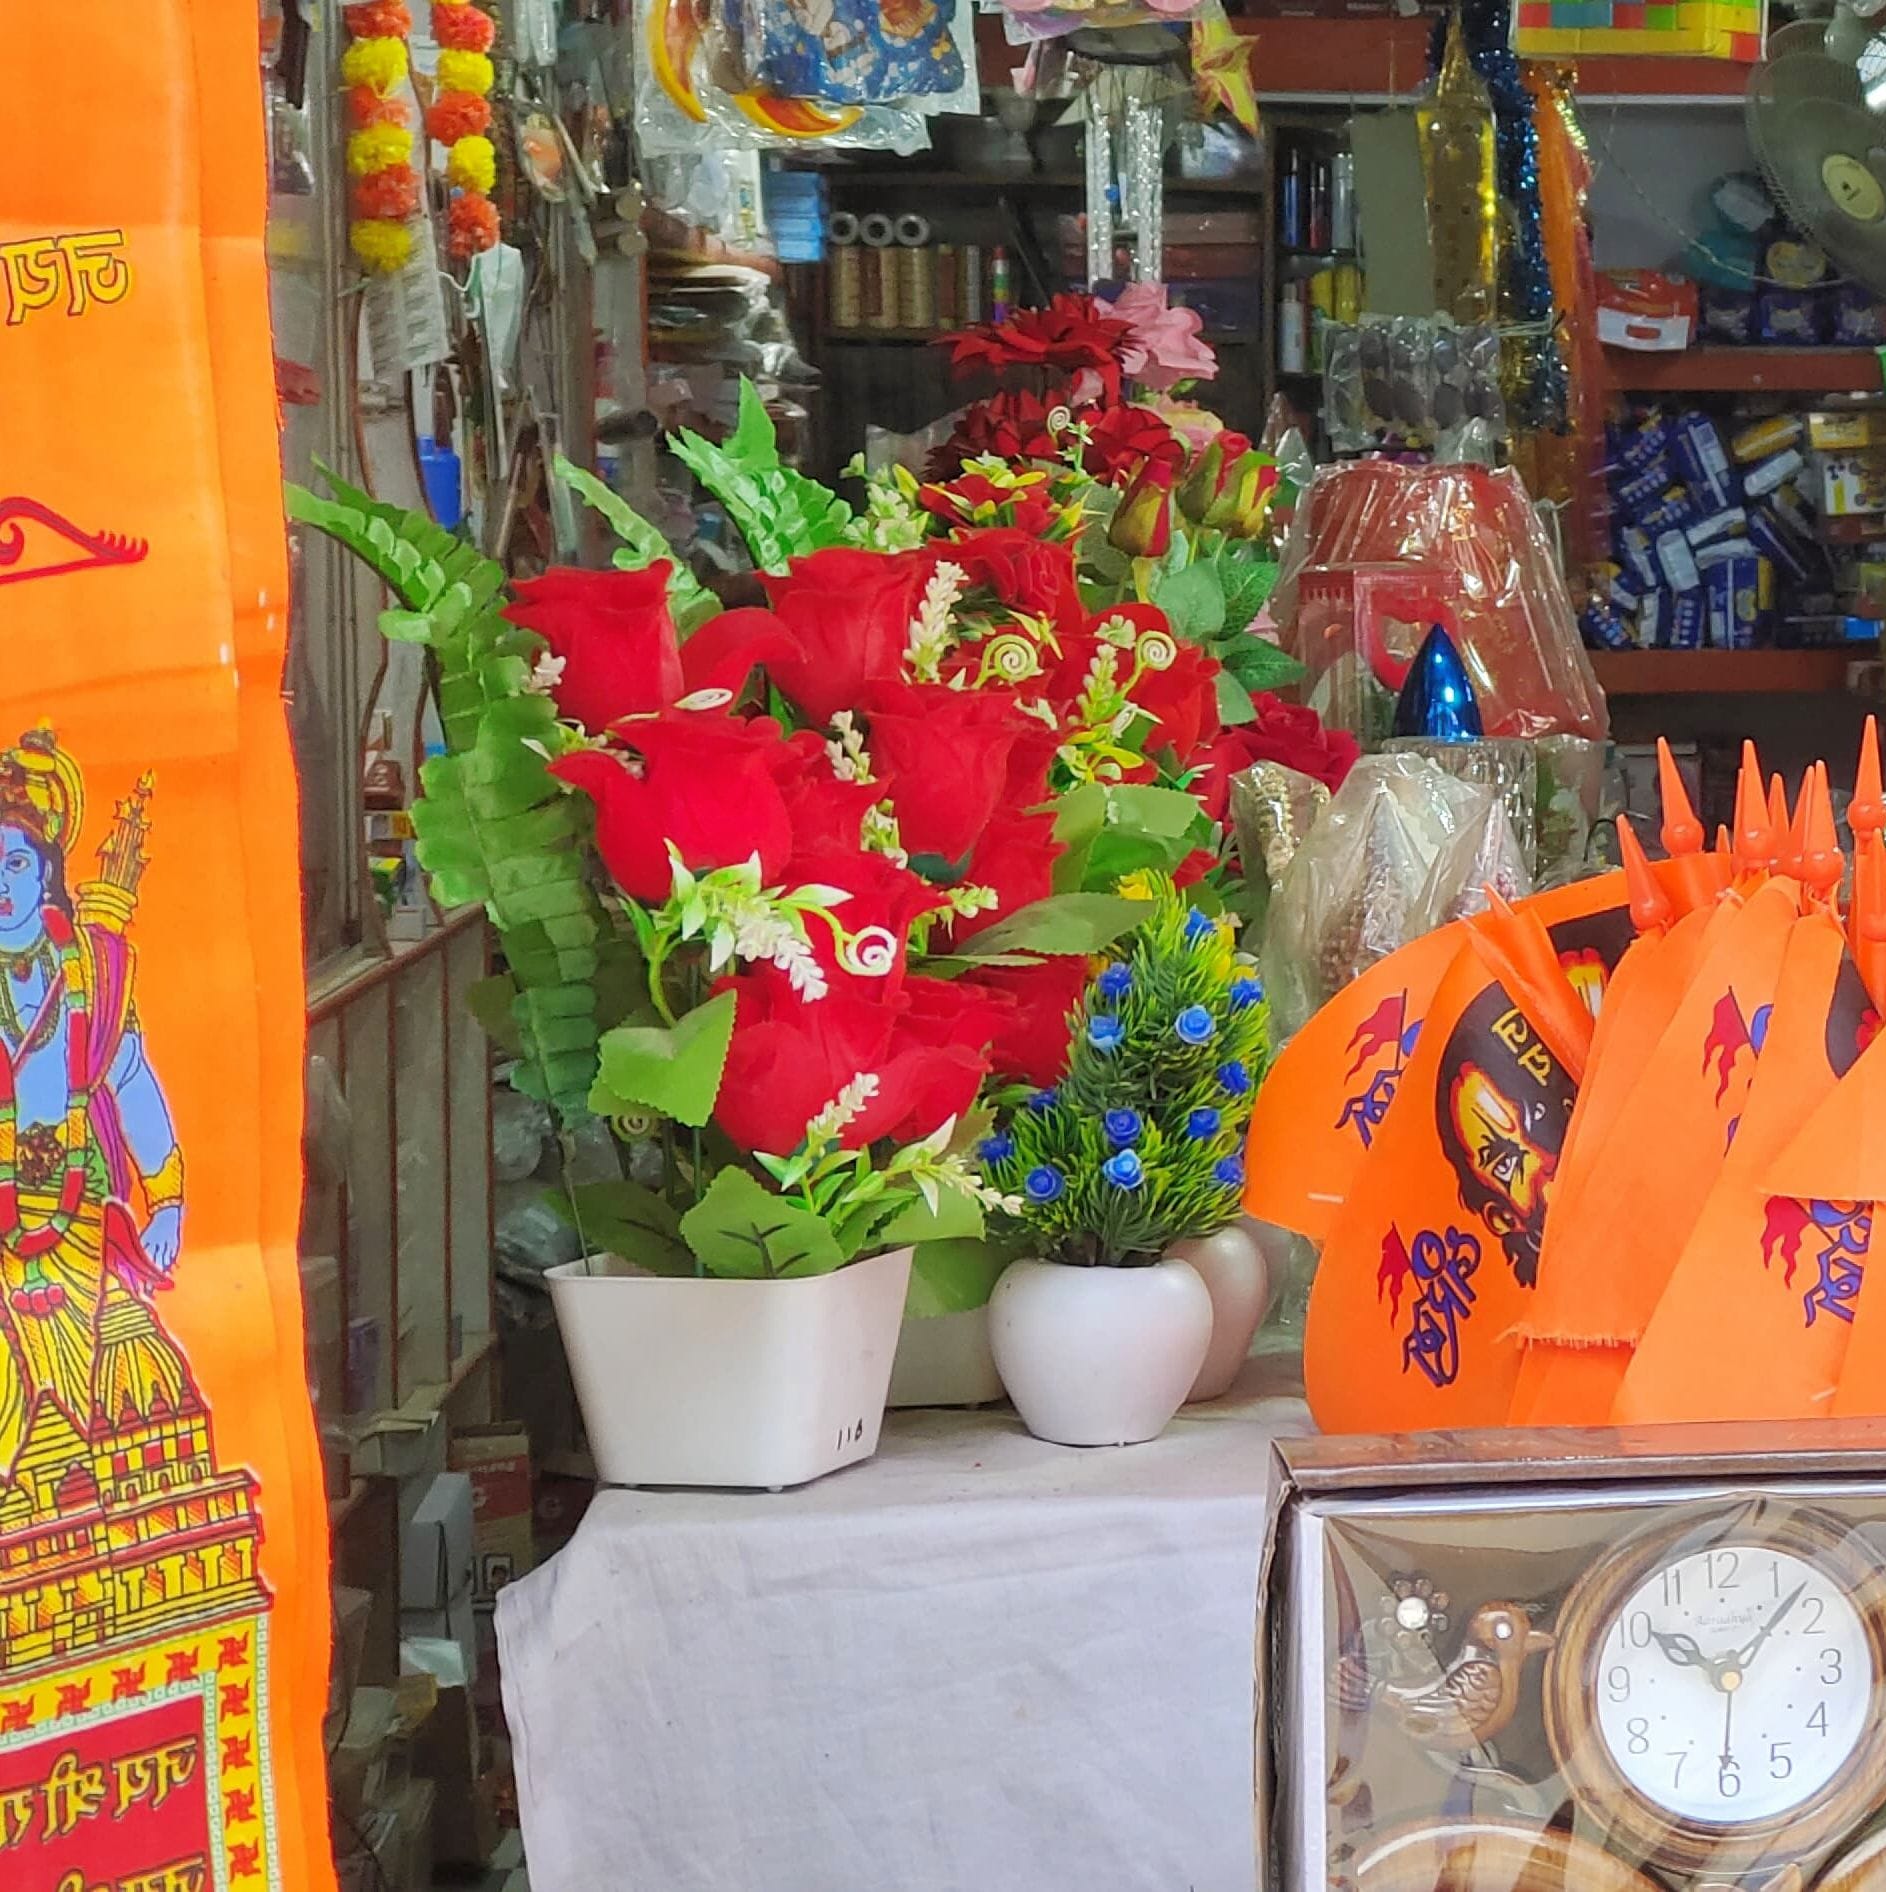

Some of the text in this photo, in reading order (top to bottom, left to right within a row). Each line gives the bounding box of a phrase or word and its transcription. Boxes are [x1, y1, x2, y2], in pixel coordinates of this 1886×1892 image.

[1661, 1568, 1681, 1607] 11
[1704, 1551, 1741, 1589] 12
[1618, 1608, 1652, 1649] 10
[1801, 1597, 1826, 1635] 2
[1607, 1665, 1631, 1703] 9
[1818, 1647, 1843, 1685] 3
[1626, 1717, 1650, 1754] 8
[1805, 1701, 1829, 1737] 4
[1665, 1751, 1688, 1789] 7
[1718, 1757, 1742, 1797] 6
[1769, 1742, 1792, 1779] 5
